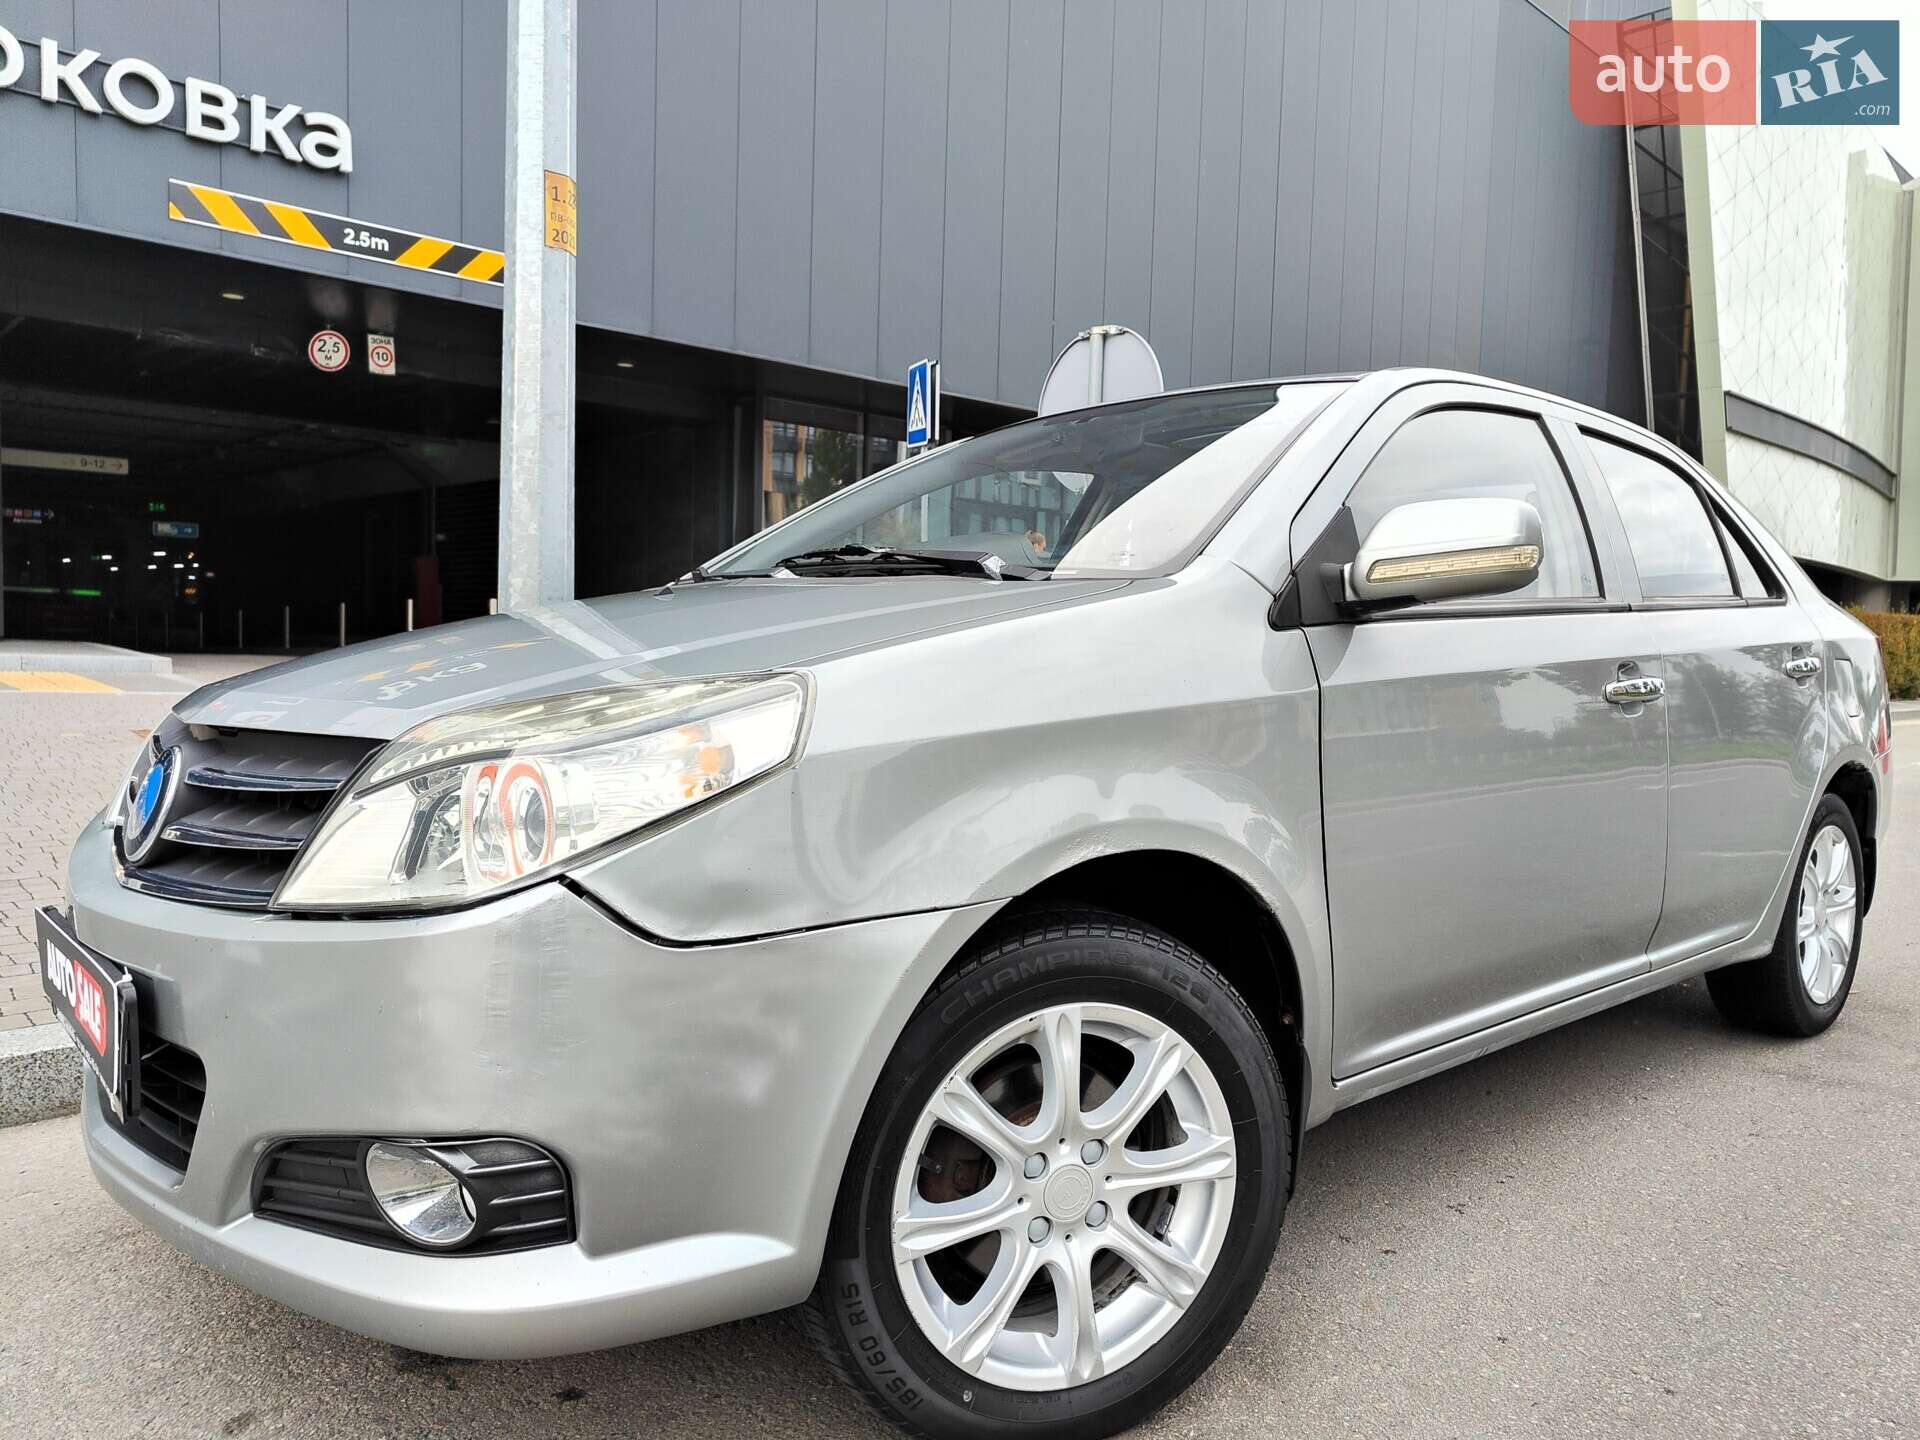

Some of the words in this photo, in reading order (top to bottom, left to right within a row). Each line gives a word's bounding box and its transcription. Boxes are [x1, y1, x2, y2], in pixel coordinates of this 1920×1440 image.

[343, 228, 389, 252] 2.5m
[371, 336, 392, 345] ЗОНА
[375, 351, 389, 362] 10
[46, 939, 76, 1008] AUTO
[841, 1282, 869, 1327] R15
[859, 1335, 925, 1410] 185/60
